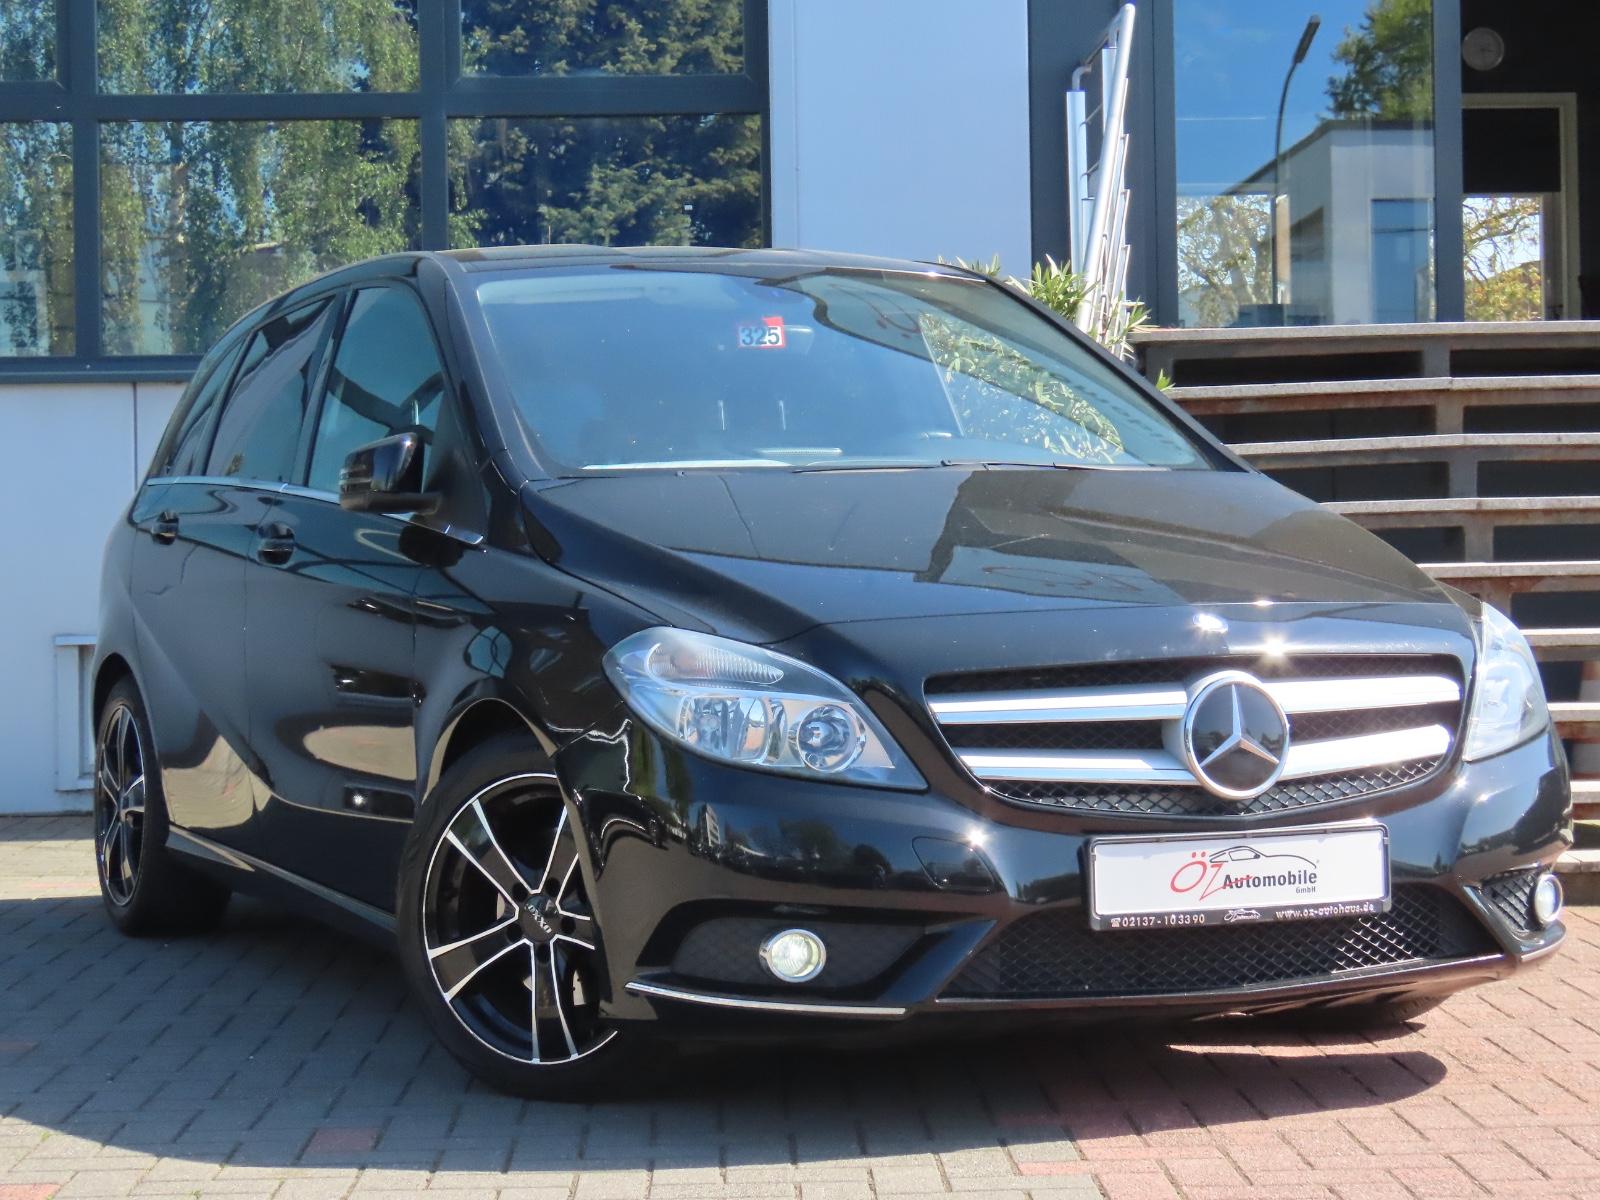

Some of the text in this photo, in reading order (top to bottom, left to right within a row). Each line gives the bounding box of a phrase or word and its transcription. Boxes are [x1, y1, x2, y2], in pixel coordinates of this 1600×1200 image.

[741, 327, 779, 346] 325
[1170, 851, 1318, 900] ÖZ Automobile
[1295, 886, 1317, 895] GmbH
[1121, 917, 1156, 928] 02137
